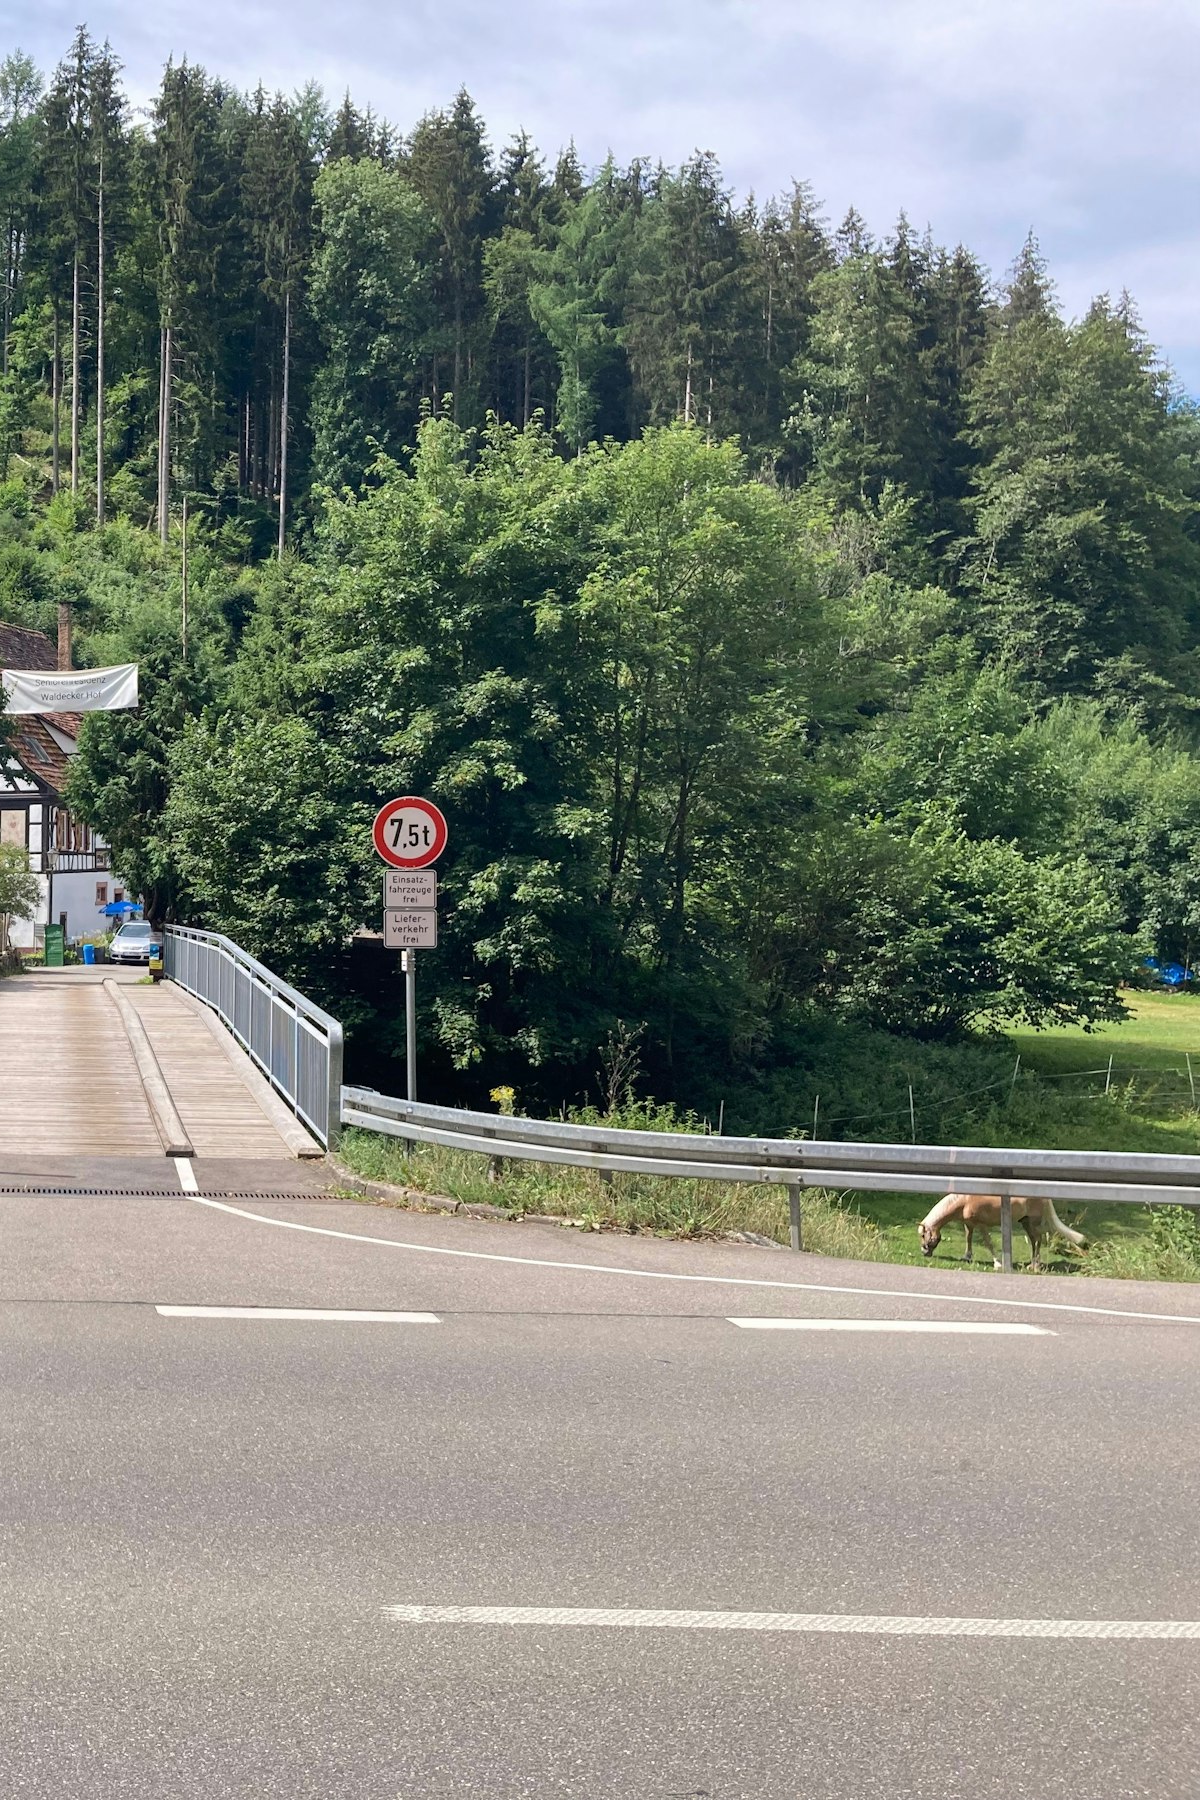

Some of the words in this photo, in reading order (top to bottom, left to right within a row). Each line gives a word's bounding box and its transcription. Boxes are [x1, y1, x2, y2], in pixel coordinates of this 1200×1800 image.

[40, 691, 84, 701] Waldecker
[86, 691, 102, 699] Hof
[392, 875, 428, 884] Einsatz-
[389, 885, 432, 895] fahrzeuge
[403, 895, 418, 903] frei
[394, 914, 427, 923] Liefer-
[392, 924, 429, 933] verkehr
[403, 934, 419, 943] frei
